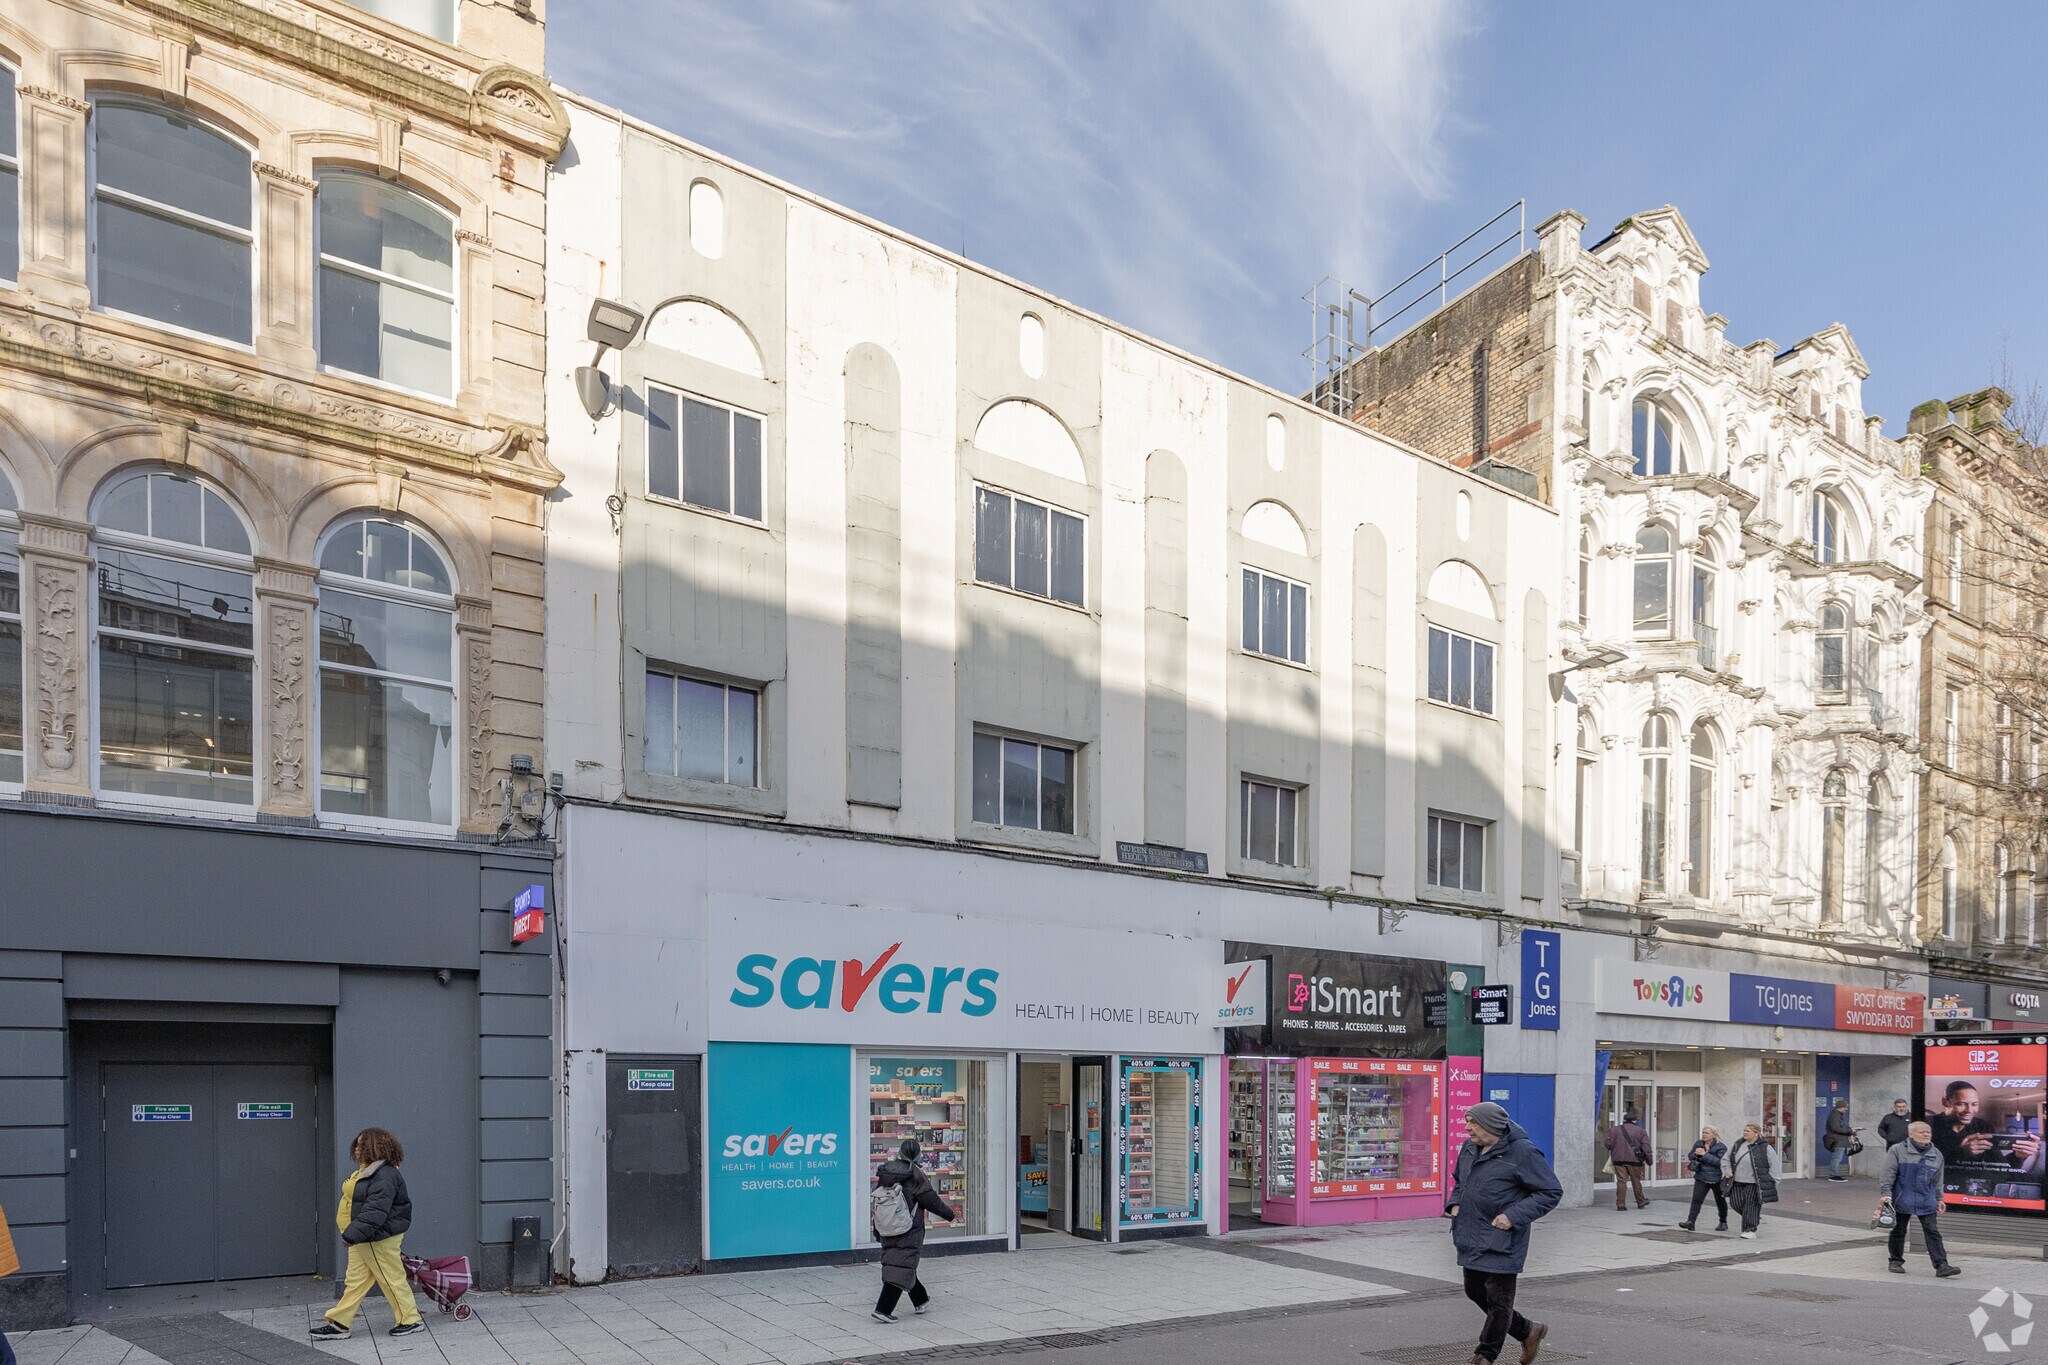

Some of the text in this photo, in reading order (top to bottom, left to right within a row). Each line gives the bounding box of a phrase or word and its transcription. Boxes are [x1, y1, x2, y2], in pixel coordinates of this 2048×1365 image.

[1120, 844, 1177, 858] QUEEN STREET
[1121, 852, 1140, 860] HEOL
[1142, 854, 1148, 862] Y
[514, 913, 530, 938] DIRECT
[729, 941, 1199, 1026] savers HEALTH HOME BEAUTY
[1310, 976, 1402, 1017] iSmart
[1478, 988, 1507, 998] iSmart
[2015, 993, 2040, 1008] COSTA
[1528, 1000, 1556, 1018] Jones
[1854, 992, 1906, 1011] POST OFFICE
[1218, 1004, 1254, 1018] savers
[1282, 1019, 1406, 1034] PHONES REPAIRS ACCESSORIES VAPES
[1846, 1010, 1914, 1029] SWYDDFA'R POST
[1986, 1050, 2000, 1062] 2
[896, 1064, 943, 1077] savers
[1460, 1070, 1481, 1080] iSmart
[722, 1126, 838, 1158] savers
[722, 1160, 839, 1172] HEALTH HOME BEAUTY
[741, 1176, 820, 1191] savers.co.uk
